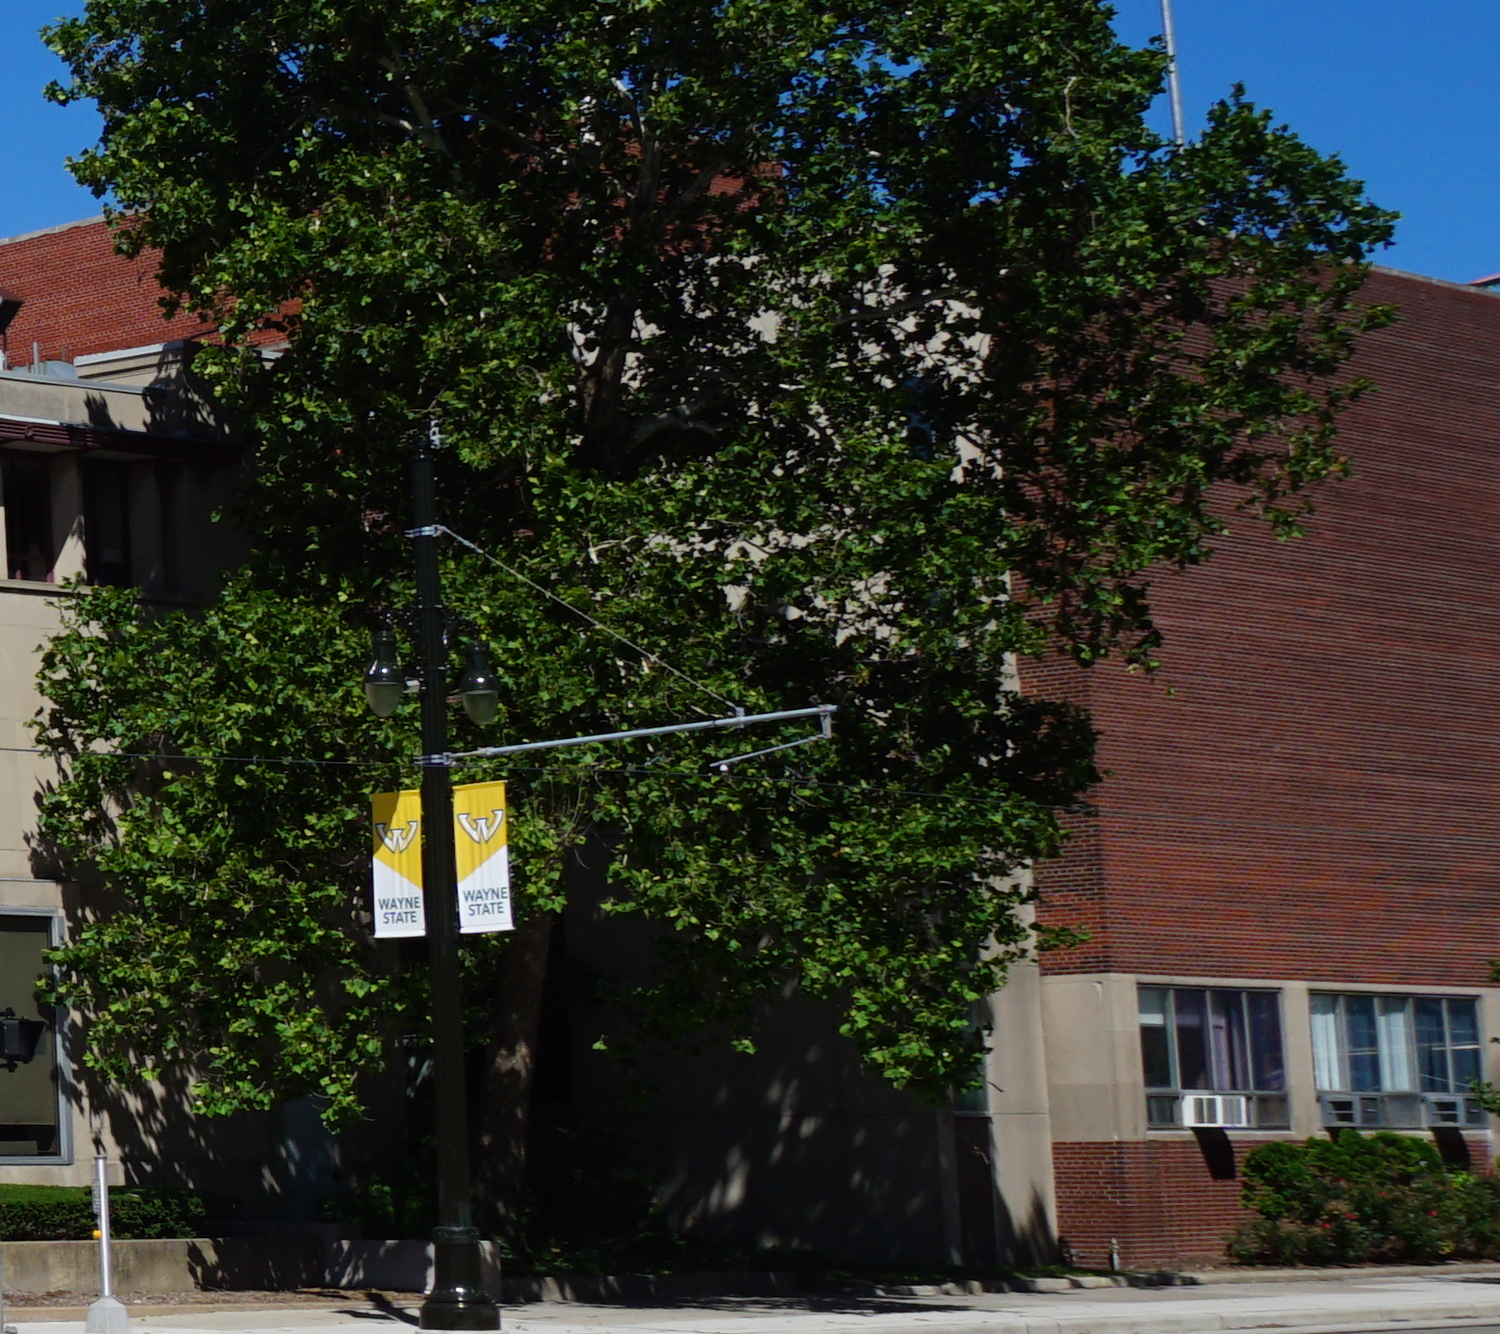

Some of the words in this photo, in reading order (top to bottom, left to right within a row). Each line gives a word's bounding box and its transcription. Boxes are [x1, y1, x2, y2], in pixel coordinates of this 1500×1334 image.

[463, 886, 508, 902] WAYNE
[378, 896, 420, 911] WAYNE
[468, 901, 504, 917] STATE
[383, 912, 417, 924] STATE
